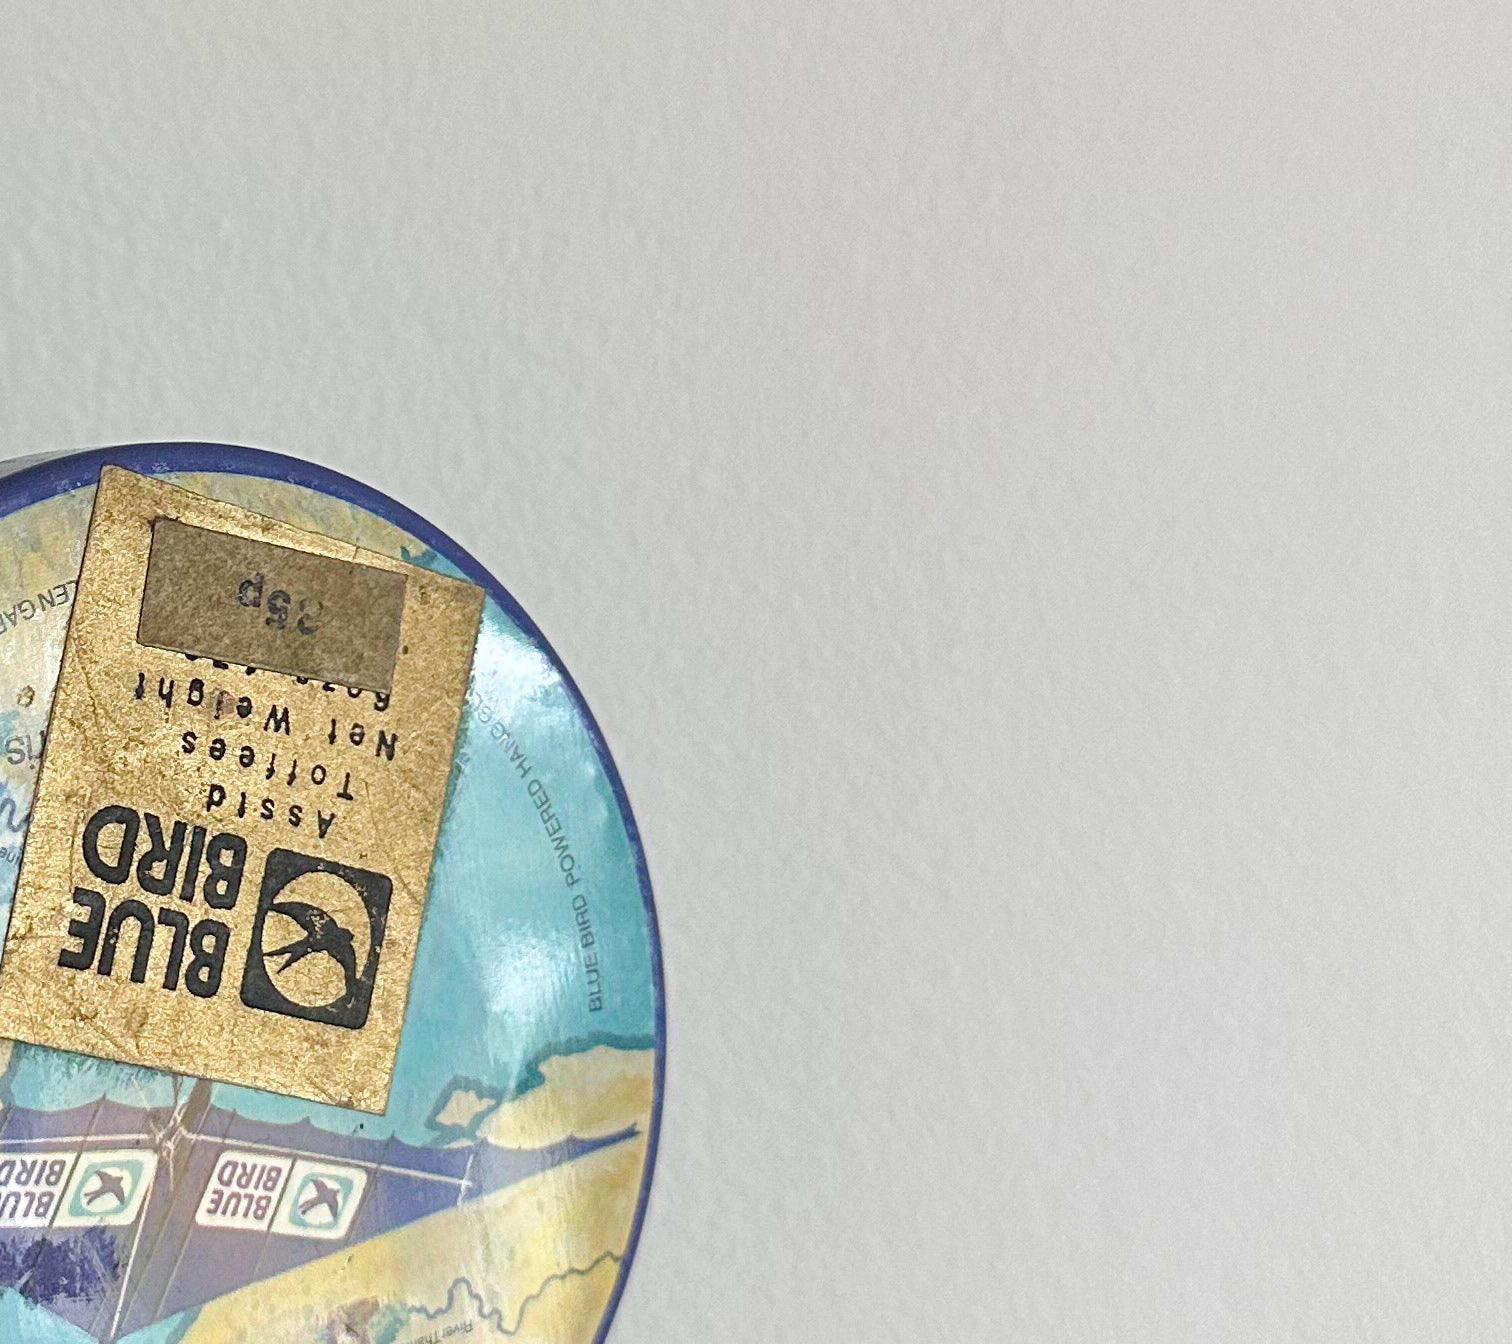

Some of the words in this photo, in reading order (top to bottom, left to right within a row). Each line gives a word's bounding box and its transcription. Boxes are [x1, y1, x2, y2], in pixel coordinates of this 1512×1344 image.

[135, 670, 291, 737] Weight
[4, 729, 46, 771] ris
[182, 728, 355, 802] Toffees
[327, 715, 399, 761] Net
[490, 719, 532, 779] HANG
[81, 802, 249, 912] BIRD
[527, 777, 583, 889] POWERED
[57, 884, 231, 1000] BLUE
[571, 893, 596, 950] BIRD
[582, 952, 603, 1013] BLUE
[205, 1189, 274, 1222] BLUE
[217, 1159, 283, 1192] BIRD
[441, 1319, 474, 1339] River
